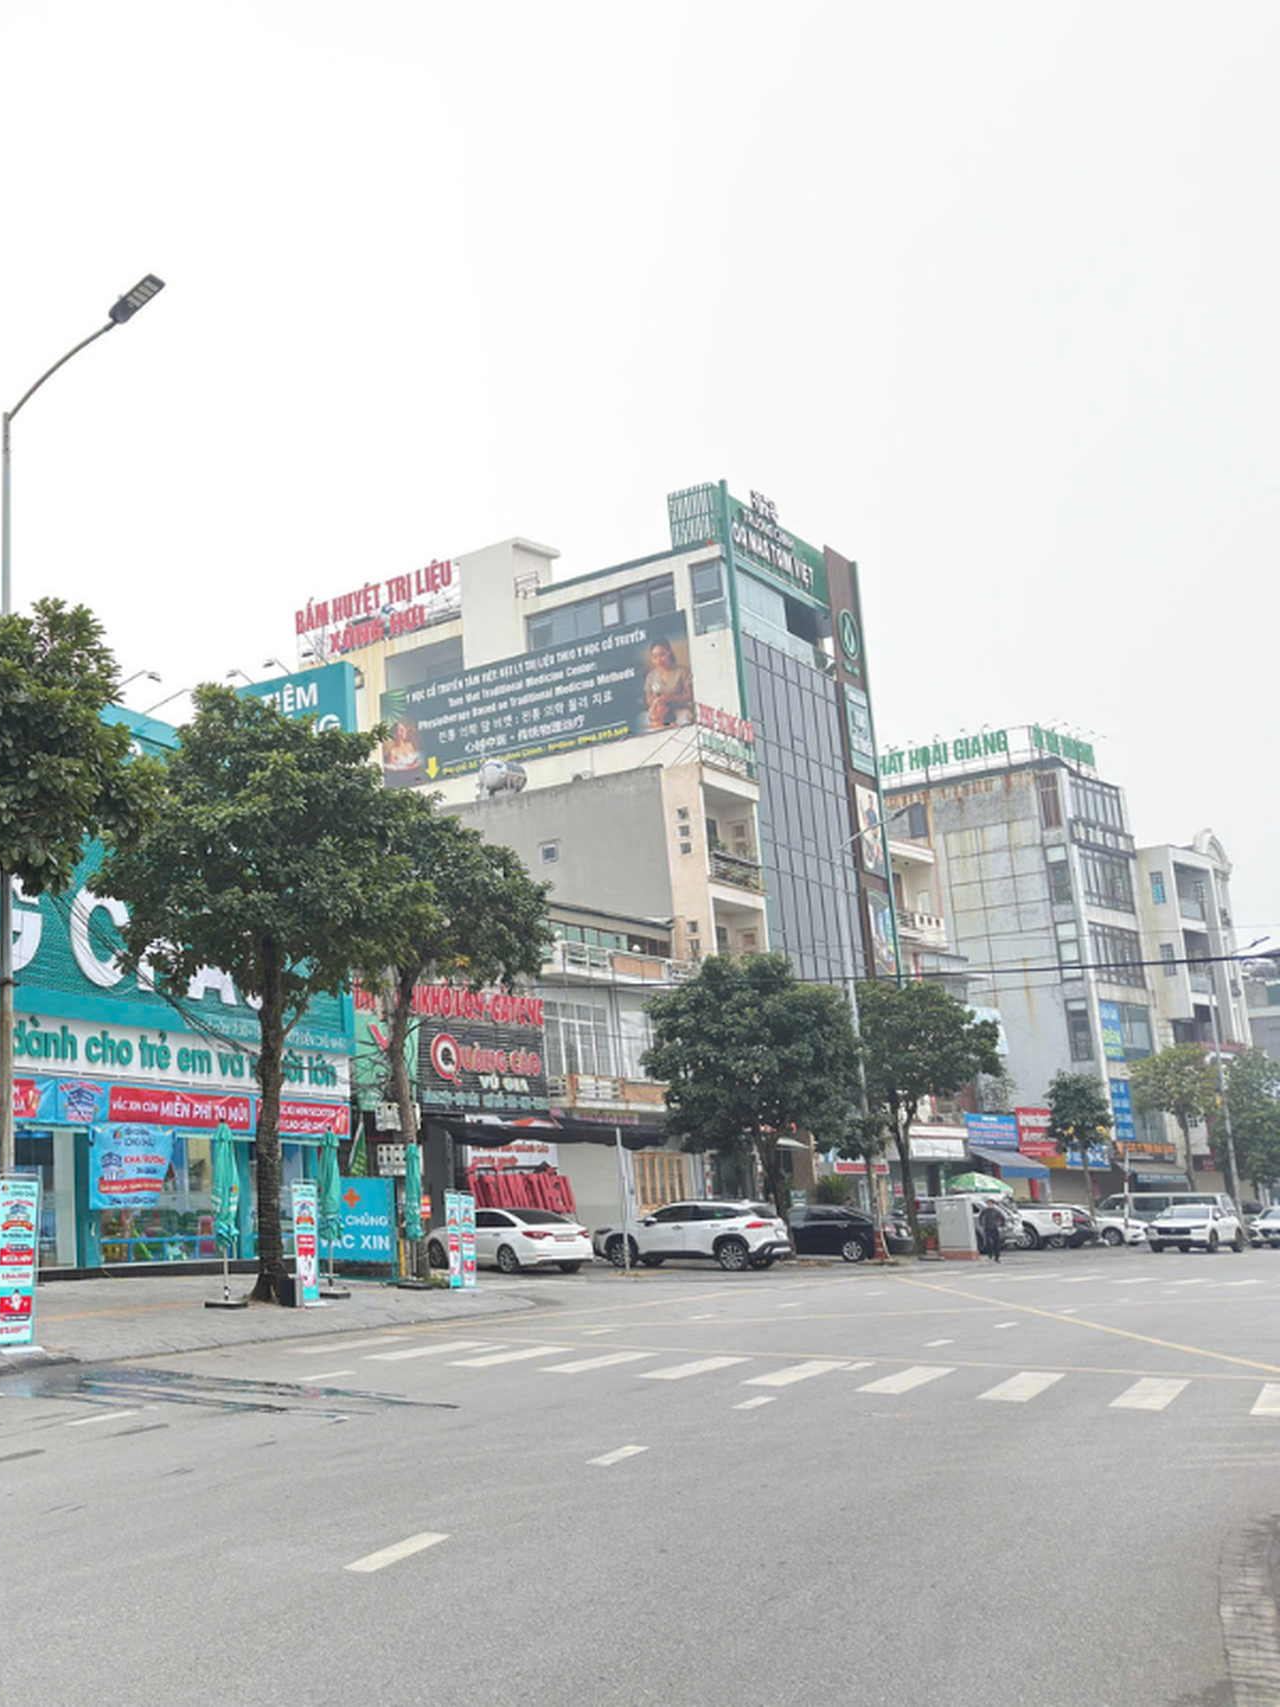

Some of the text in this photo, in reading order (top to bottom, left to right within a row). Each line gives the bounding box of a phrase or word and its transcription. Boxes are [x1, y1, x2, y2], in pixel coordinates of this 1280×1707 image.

[909, 739, 948, 769] HOÀI
[953, 729, 1008, 762] GIANG
[85, 1029, 133, 1067] cho
[139, 1030, 170, 1070] trẻ
[177, 1046, 212, 1074] em
[431, 1033, 542, 1086] QUẢNG CÁO
[192, 1100, 213, 1120] PHÍ
[361, 1235, 390, 1250] XIN
